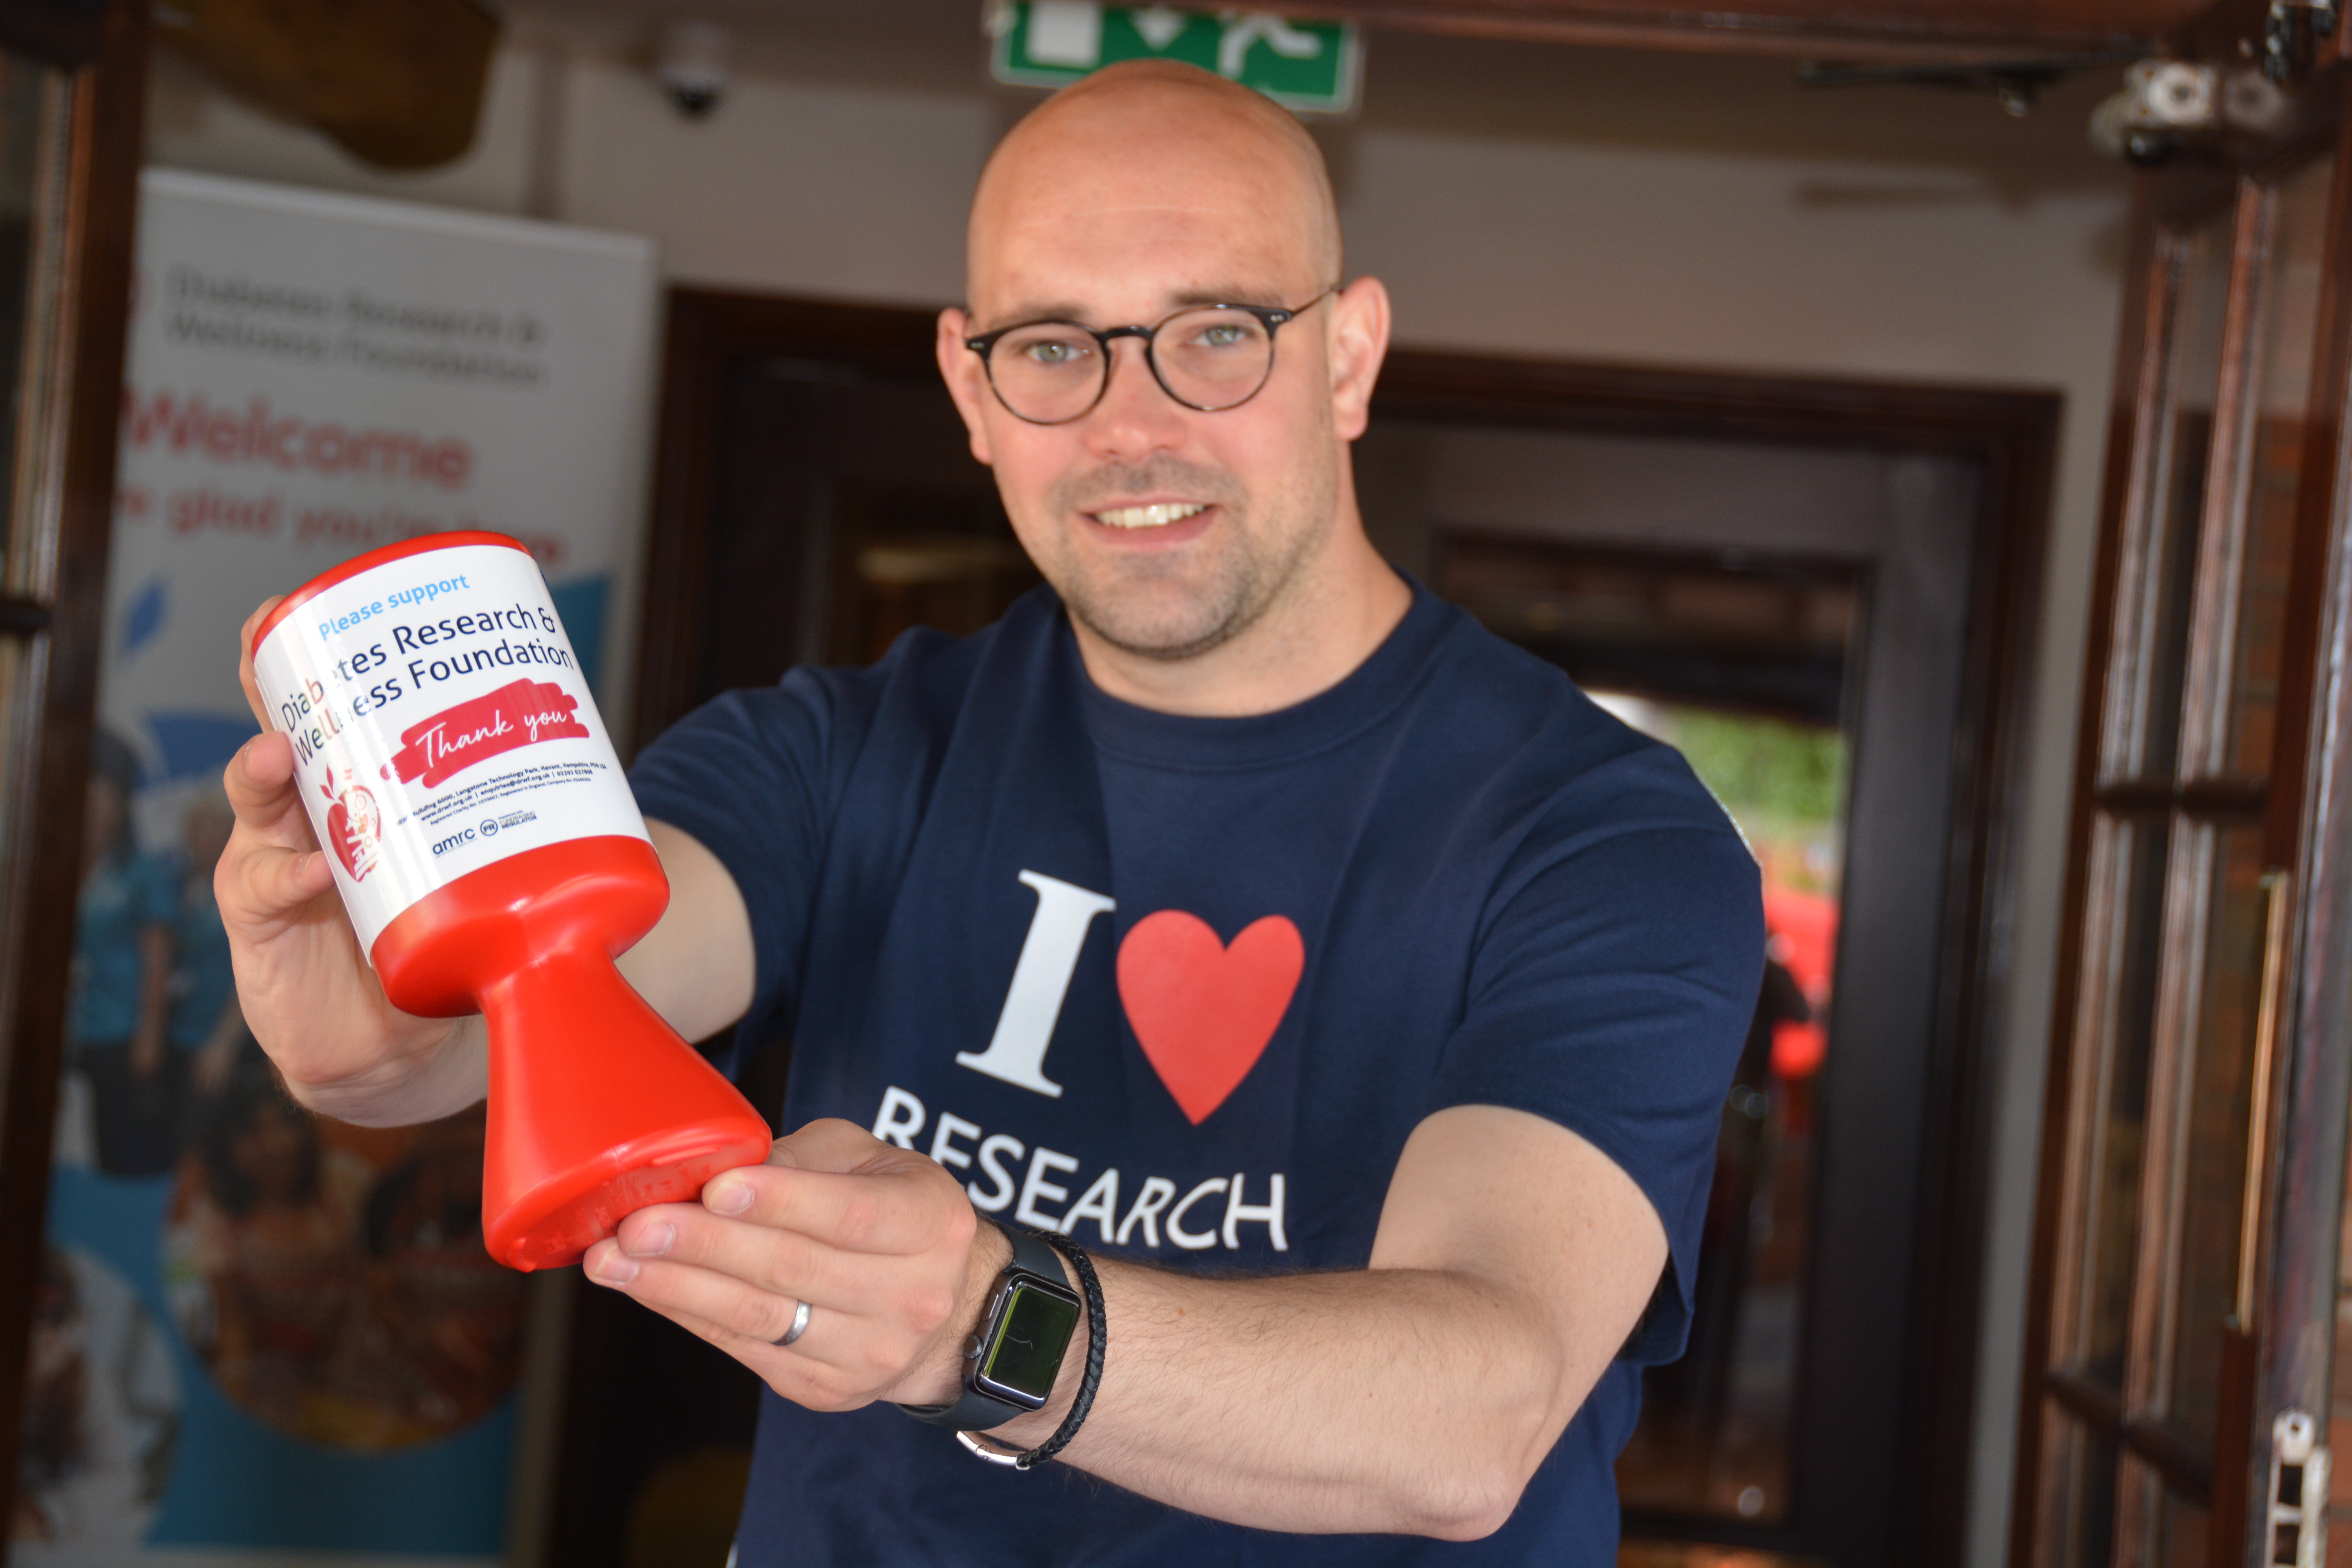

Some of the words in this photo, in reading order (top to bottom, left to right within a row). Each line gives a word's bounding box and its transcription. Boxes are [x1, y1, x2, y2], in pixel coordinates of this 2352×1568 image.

[319, 601, 383, 641] Please
[388, 574, 470, 608] support
[281, 643, 387, 733] Diabtes
[392, 603, 537, 654] Research
[538, 607, 555, 633] &
[295, 678, 402, 766] Welless
[408, 638, 574, 689] Foundation
[415, 710, 514, 768] Thank
[524, 711, 567, 742] you
[412, 802, 437, 817] Building
[437, 794, 455, 804] 6000,
[456, 781, 488, 796] Langstone
[488, 771, 524, 784] Technology
[524, 766, 540, 775] Park,
[421, 795, 473, 821] www.drwf.org.uk
[480, 773, 550, 795] enquiries@drwf.org.uk
[453, 806, 469, 815] Charity
[432, 828, 475, 855] amrc
[483, 823, 495, 833] FR
[501, 816, 537, 829] REGULATOR
[955, 869, 1116, 1098] I
[872, 1085, 1289, 1251] RESEARCH
